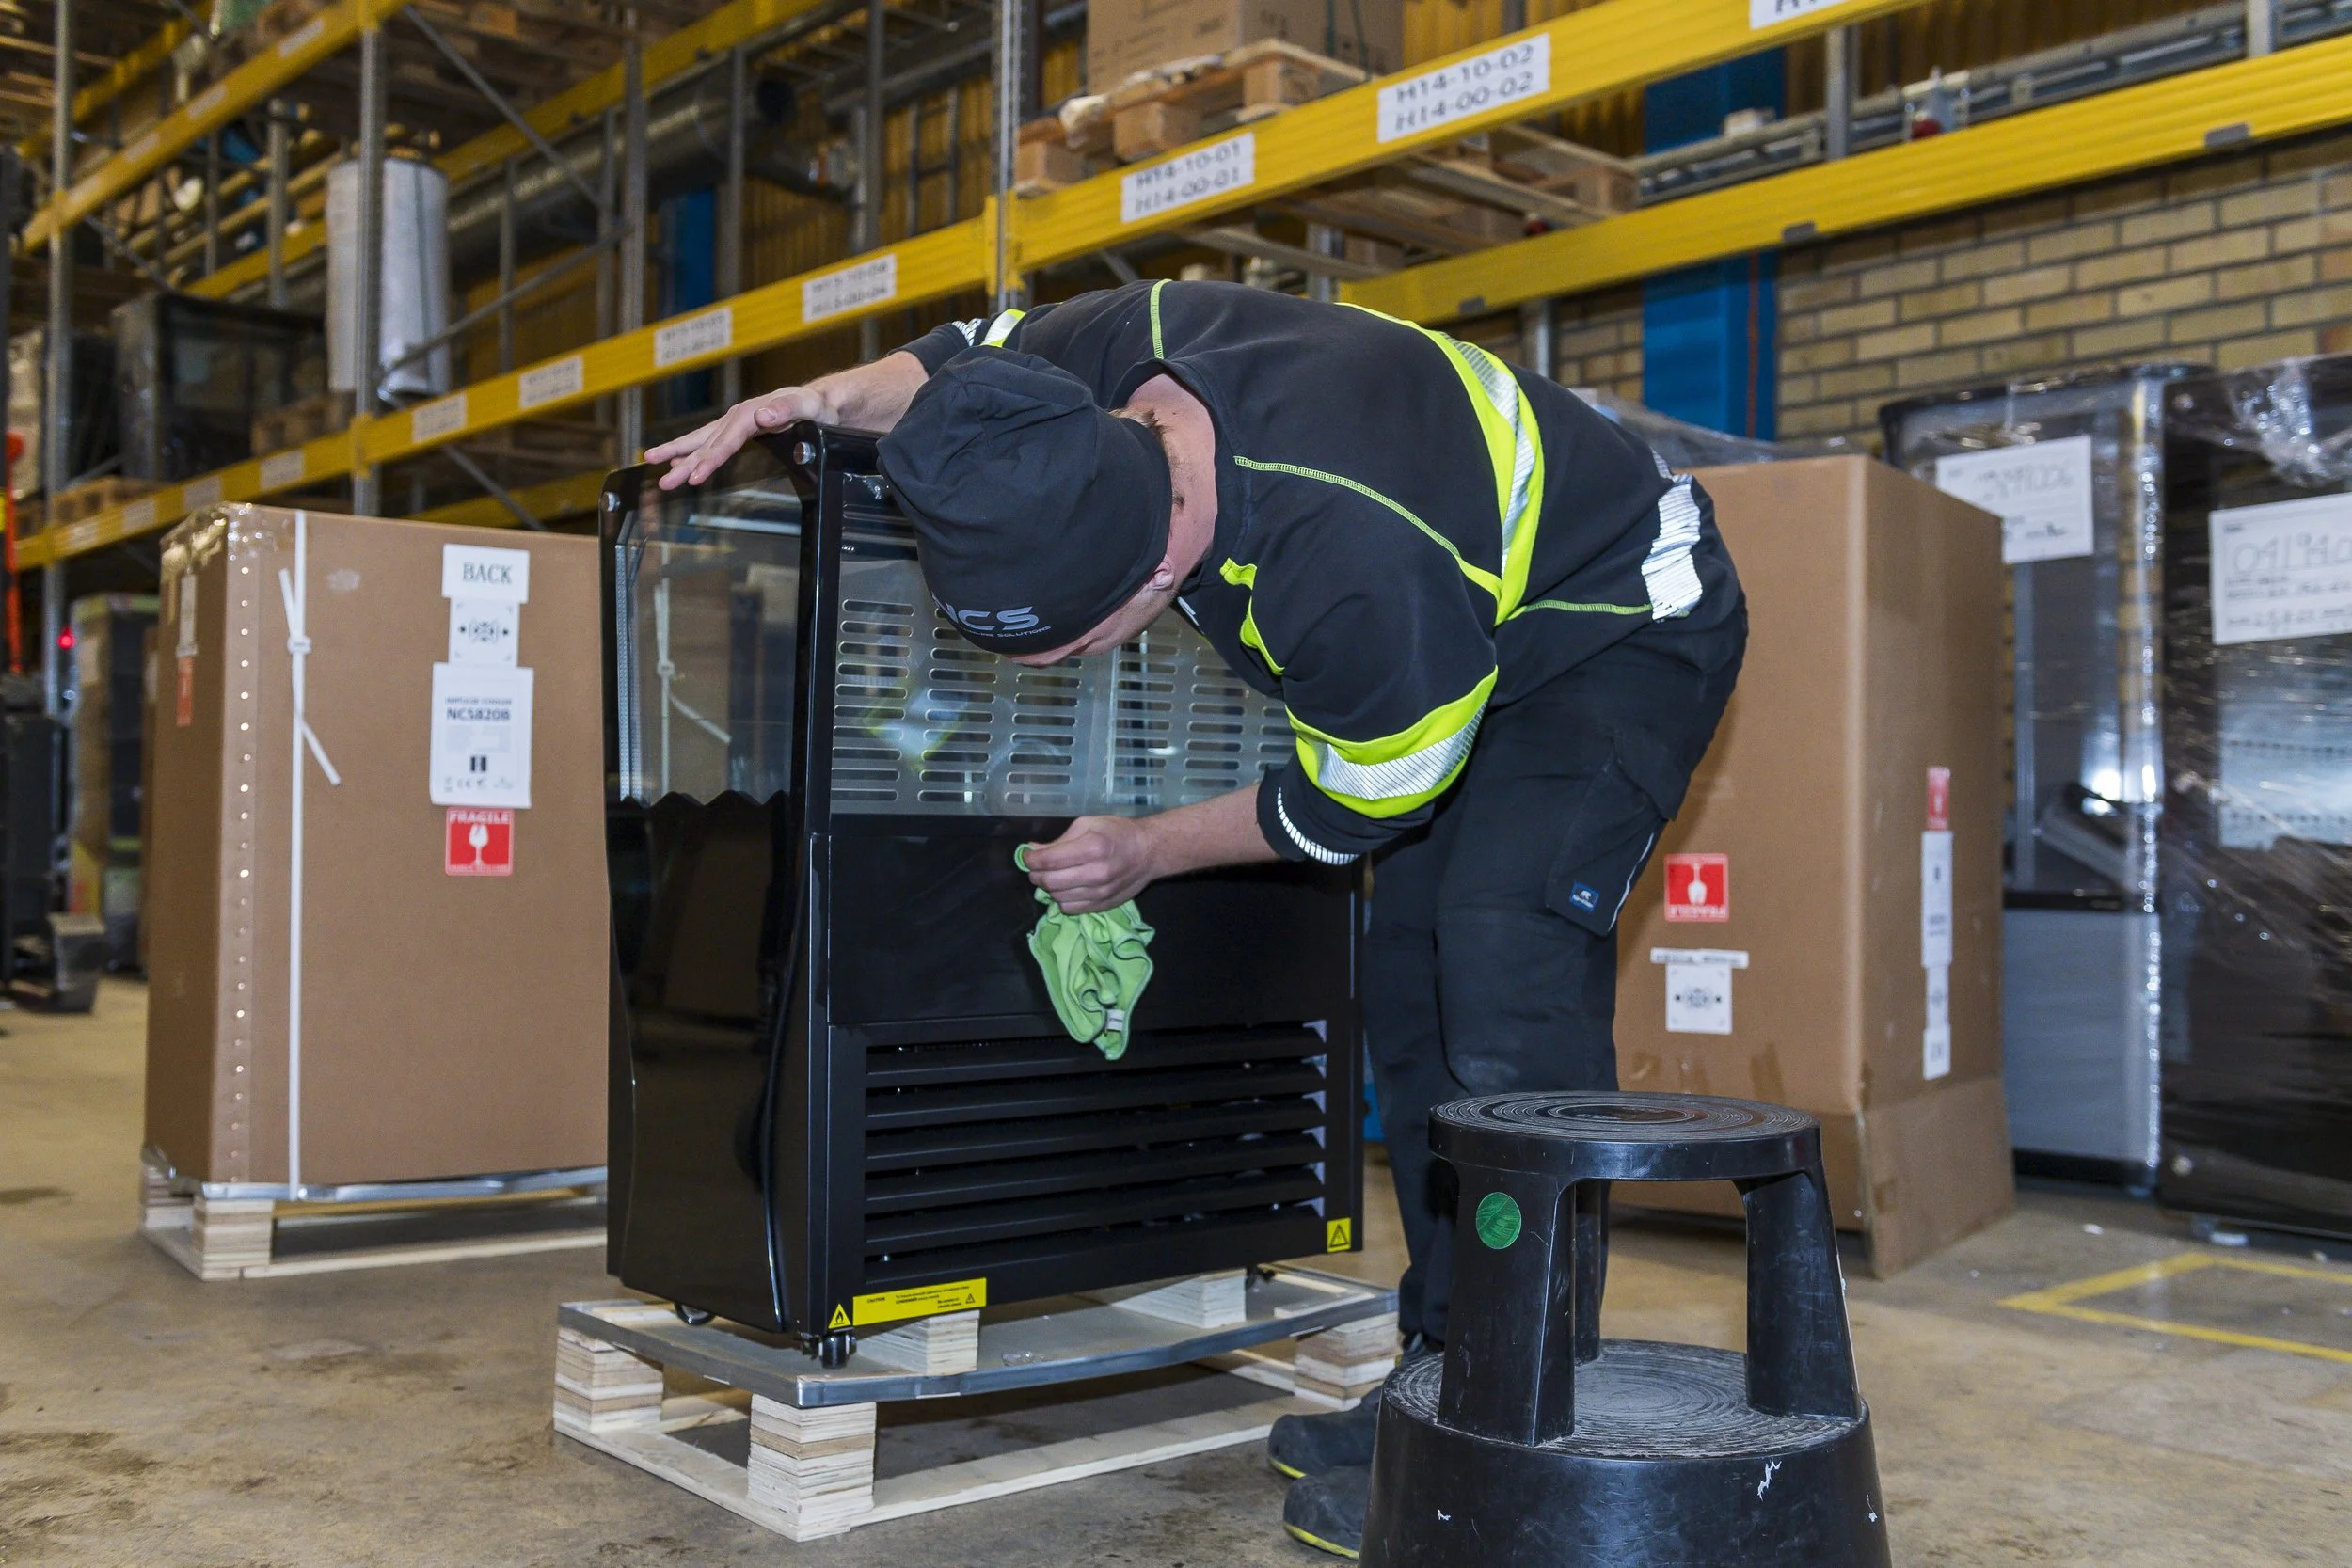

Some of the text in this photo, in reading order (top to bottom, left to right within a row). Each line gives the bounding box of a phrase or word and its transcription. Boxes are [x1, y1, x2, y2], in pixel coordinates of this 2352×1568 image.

[1396, 44, 1534, 103] H14-10-02
[1395, 71, 1533, 131] H14-00-02
[462, 562, 512, 585] BACK
[997, 625, 1051, 638] SOLUTIONS
[449, 811, 510, 824] FRAGILE
